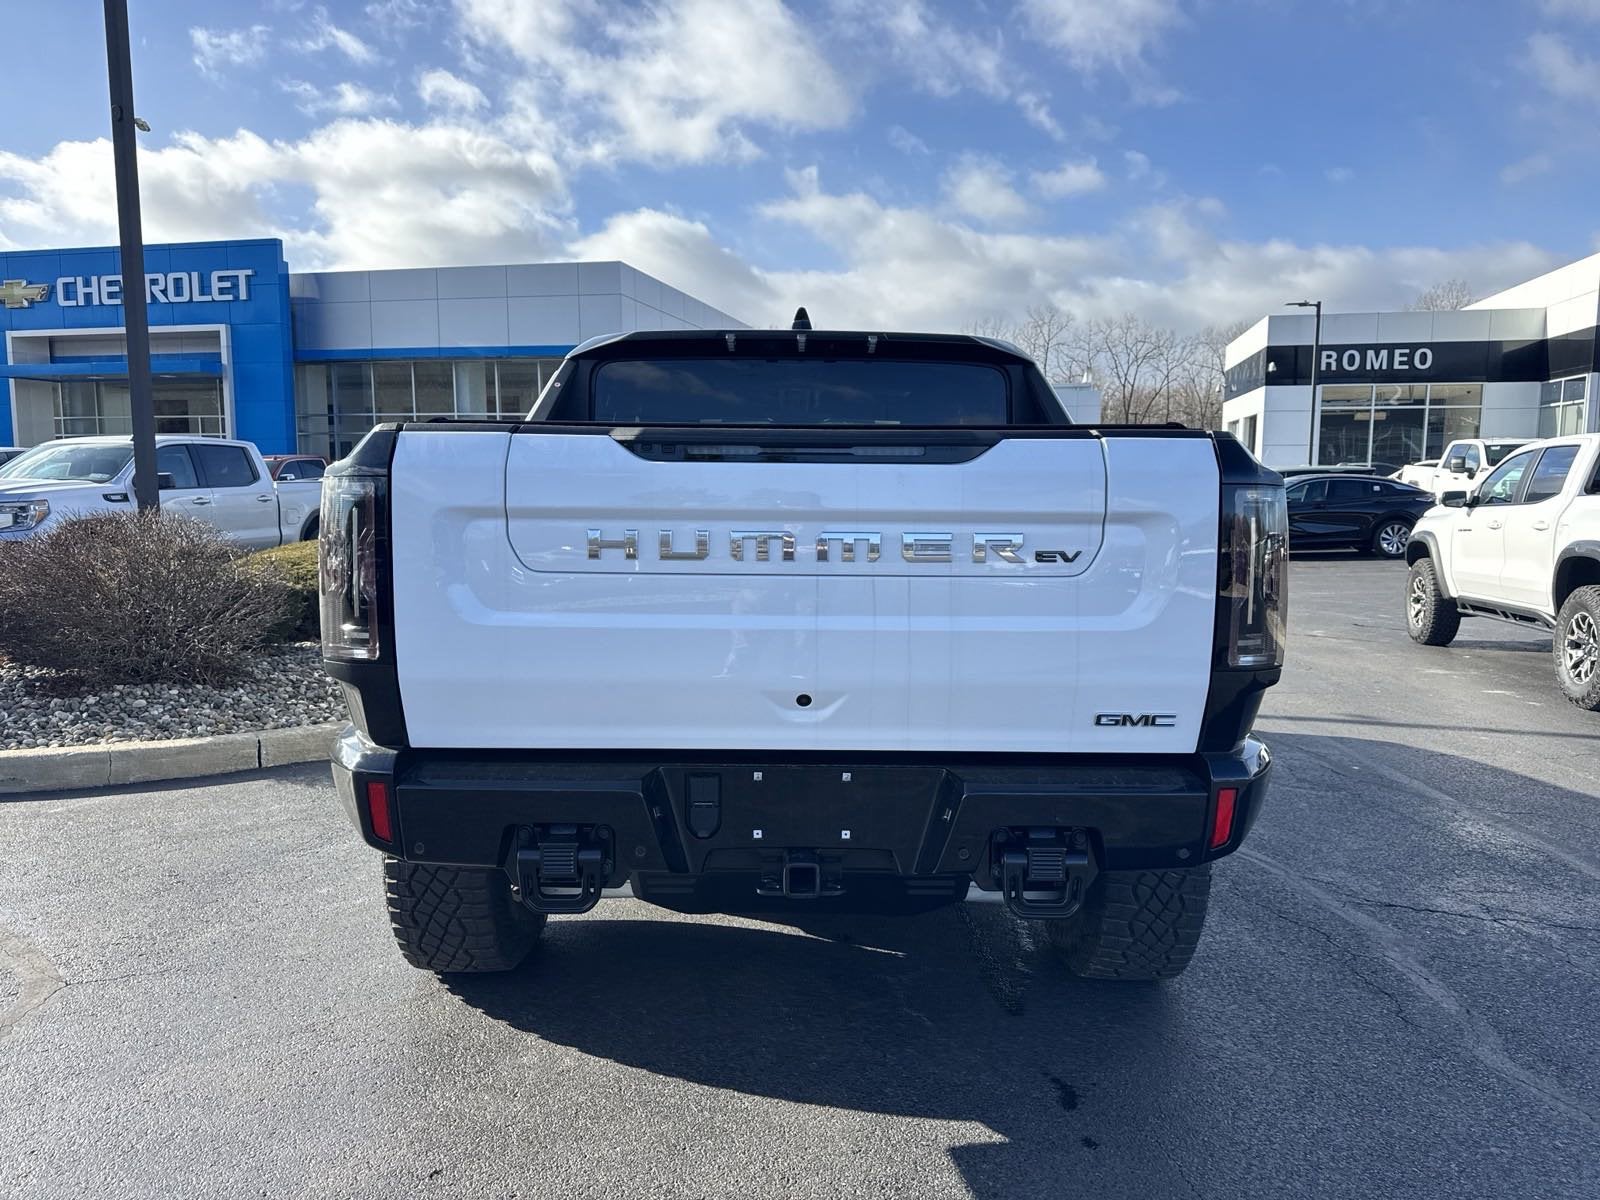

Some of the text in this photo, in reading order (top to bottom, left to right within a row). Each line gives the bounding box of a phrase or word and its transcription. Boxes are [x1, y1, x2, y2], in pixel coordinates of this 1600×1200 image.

[56, 269, 254, 306] CHEROLET
[1320, 348, 1432, 371] ROMEO
[586, 529, 1082, 563] HUMMER EV
[1094, 713, 1177, 727] GMC
